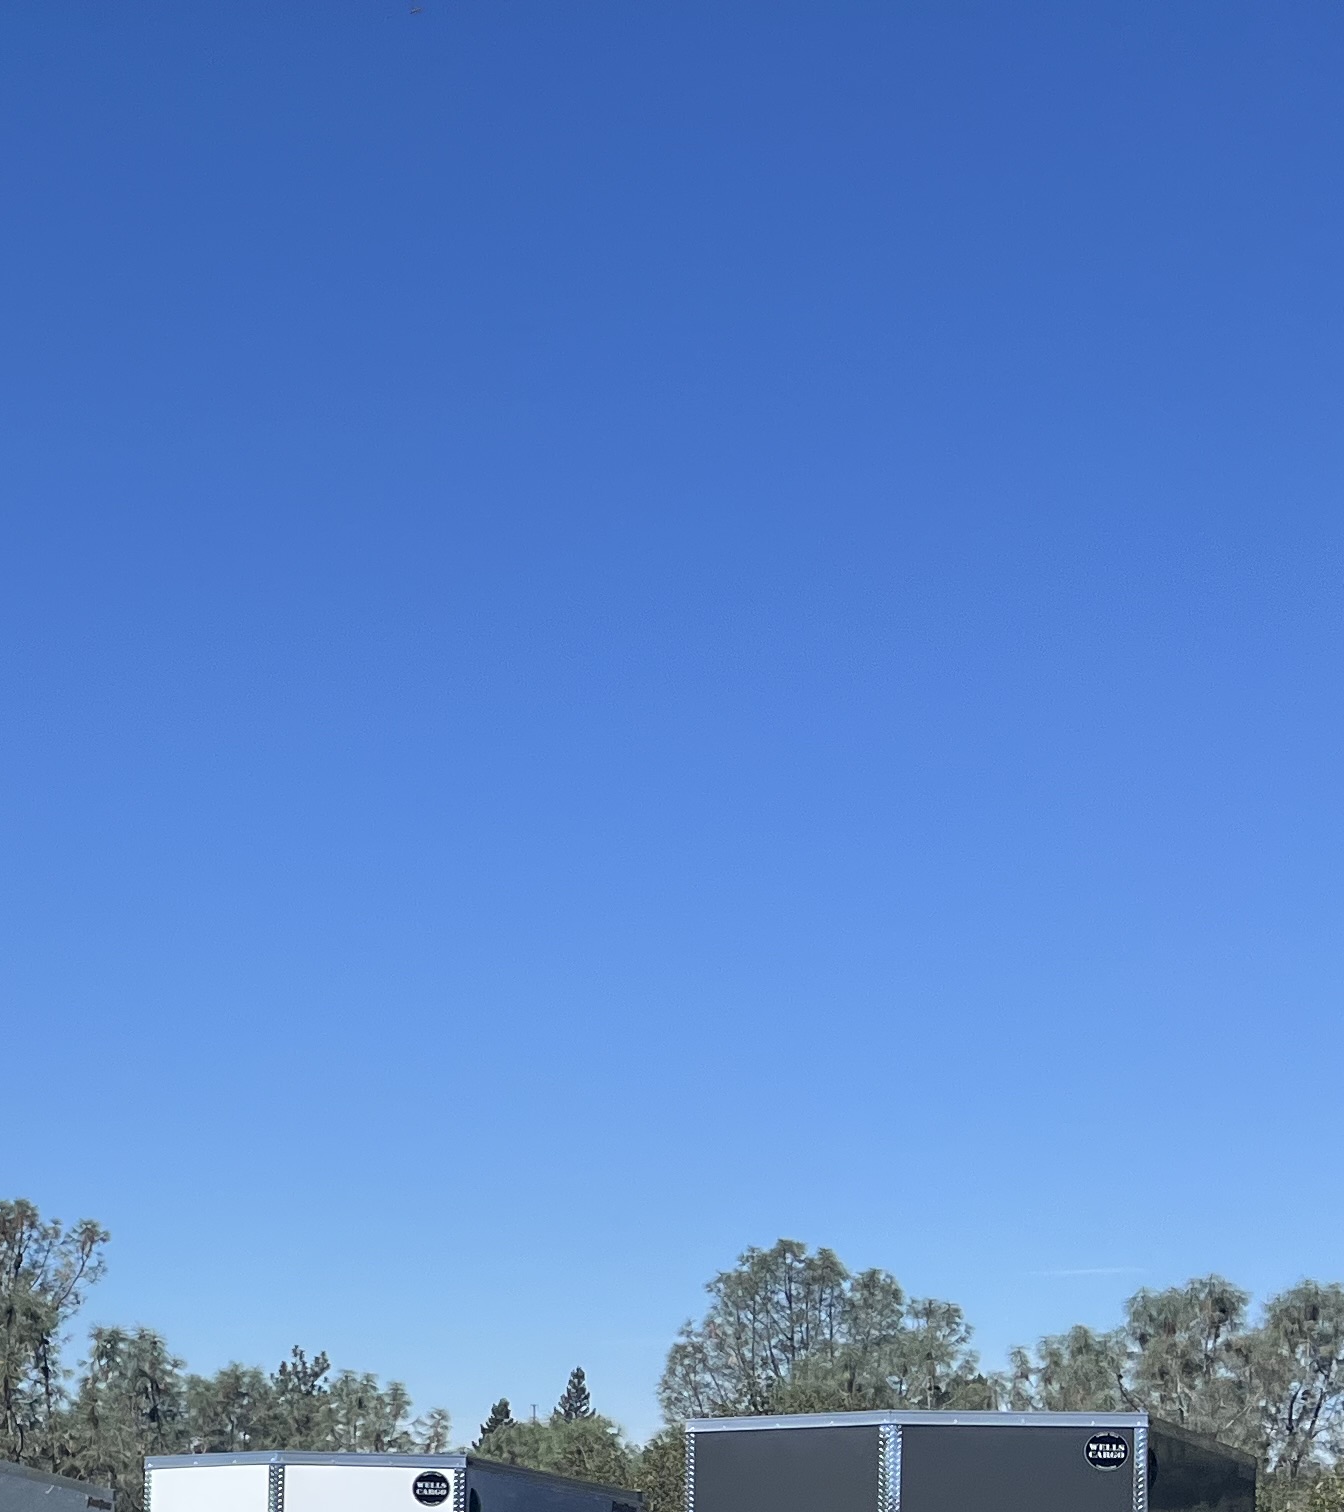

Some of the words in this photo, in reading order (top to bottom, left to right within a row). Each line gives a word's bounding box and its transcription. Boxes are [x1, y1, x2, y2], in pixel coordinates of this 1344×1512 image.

[1089, 1443, 1125, 1451] WELLS
[1088, 1451, 1125, 1459] CARGO
[416, 1481, 447, 1489] WELLS
